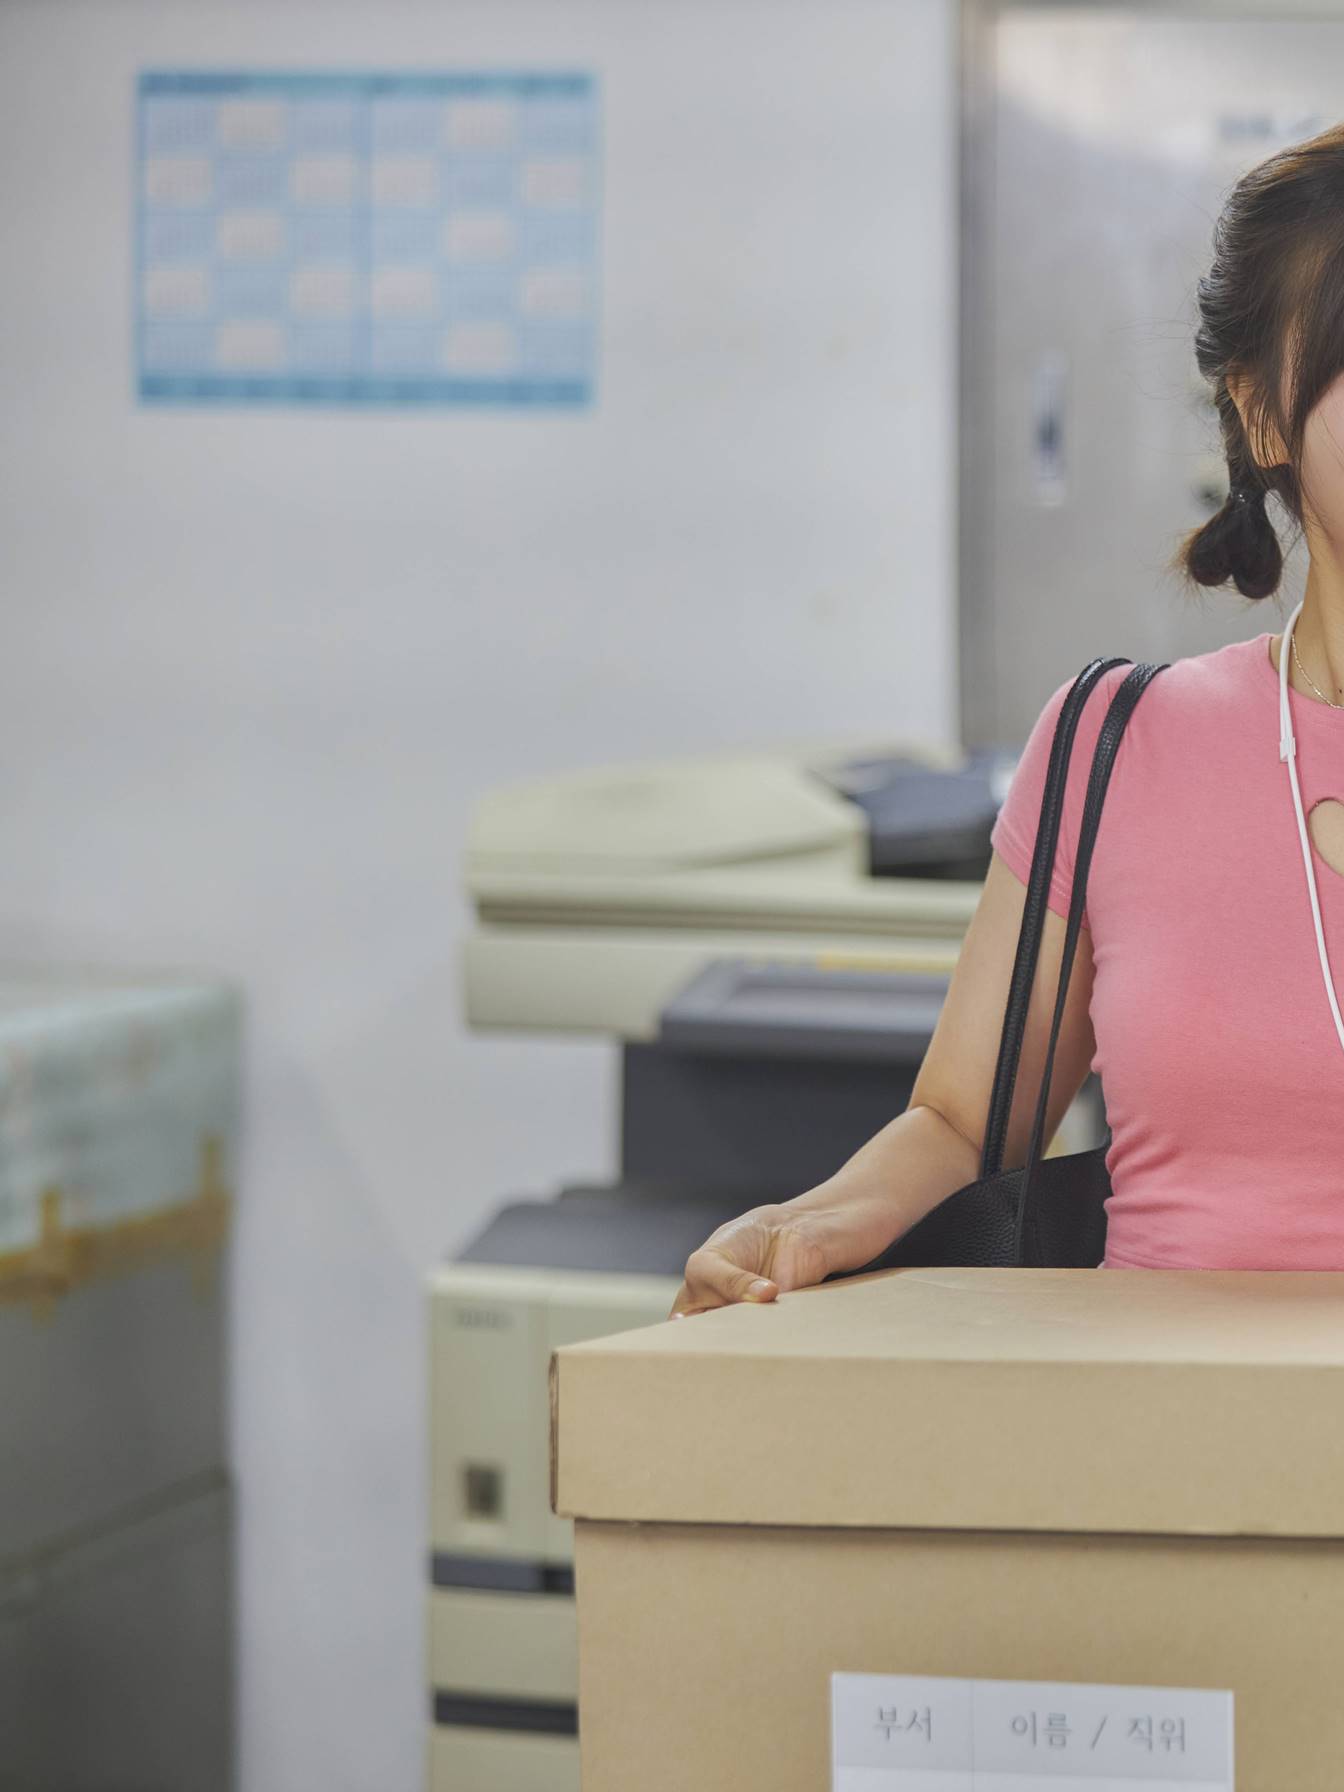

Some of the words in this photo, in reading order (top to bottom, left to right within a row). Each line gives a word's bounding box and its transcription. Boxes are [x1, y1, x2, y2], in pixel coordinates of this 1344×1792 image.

[873, 1705, 934, 1743] 부서
[1010, 1711, 1072, 1751] 이름
[1090, 1715, 1108, 1751] /
[1126, 1717, 1188, 1754] 직위
